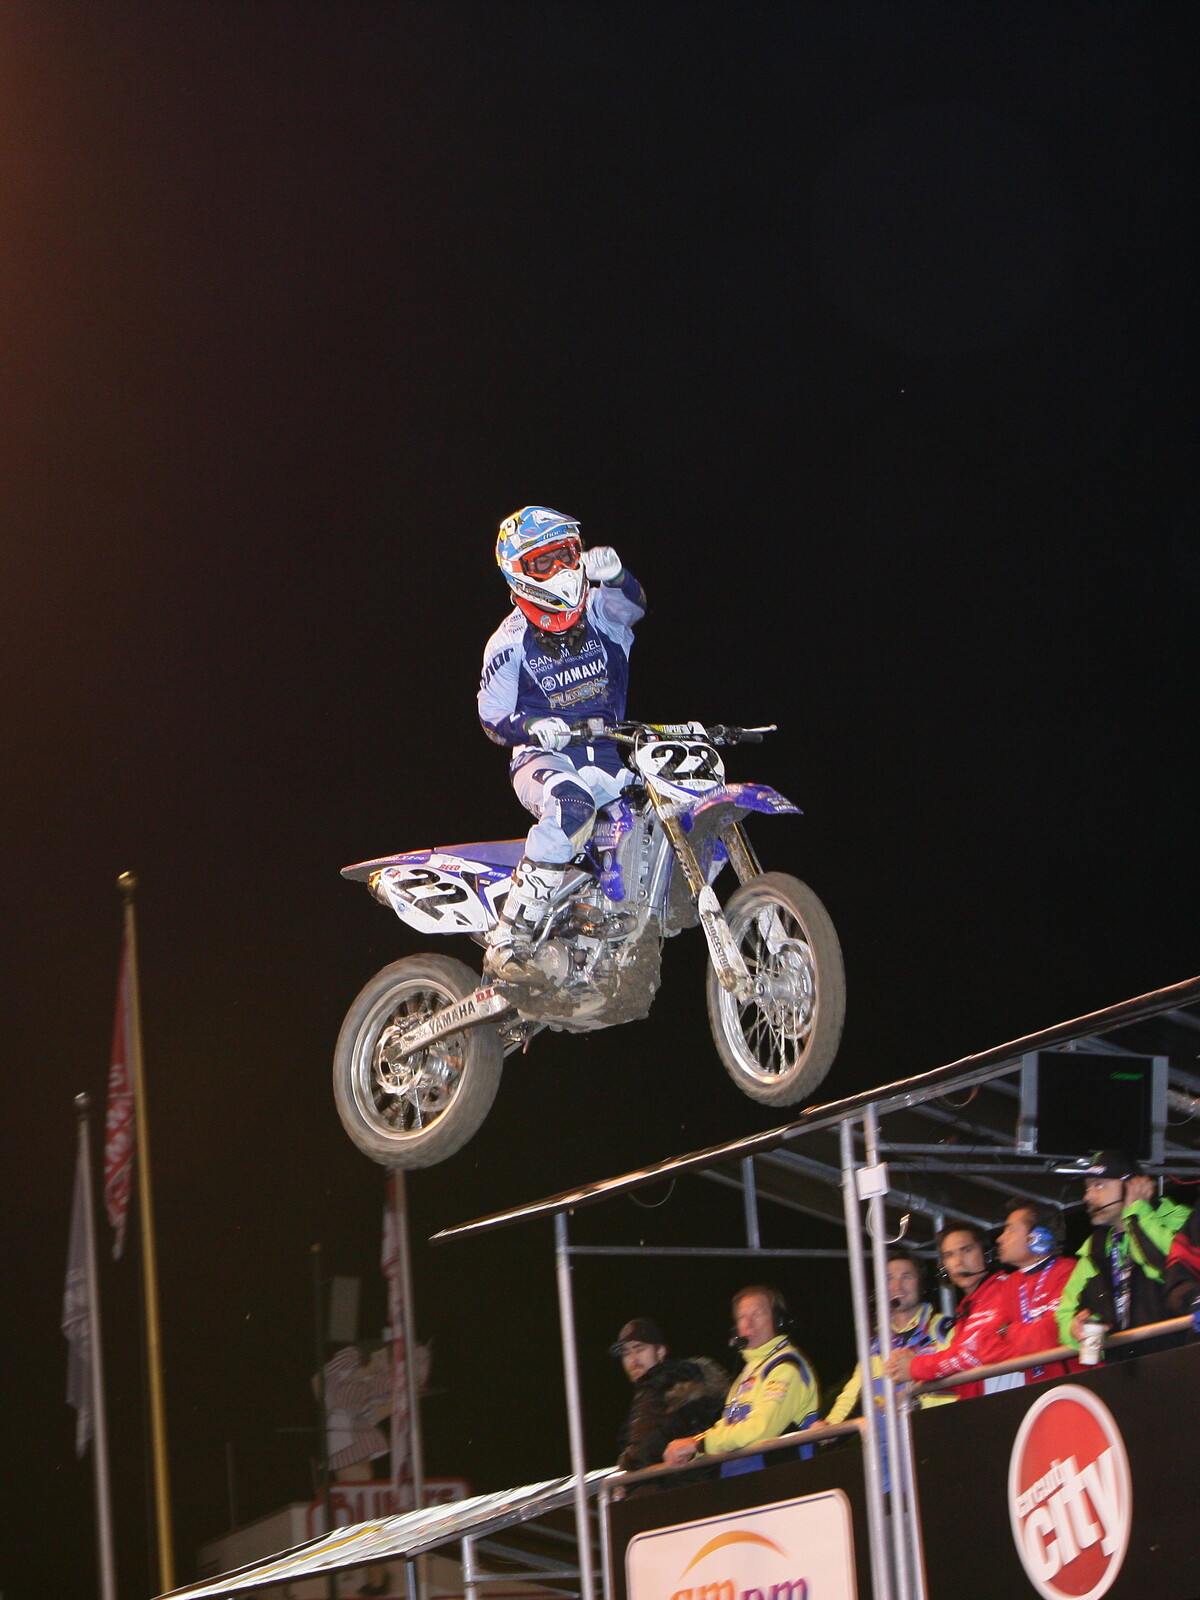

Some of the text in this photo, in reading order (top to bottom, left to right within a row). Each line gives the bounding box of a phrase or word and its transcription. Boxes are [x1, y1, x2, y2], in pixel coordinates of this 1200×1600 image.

[529, 639, 601, 669] SAN MUEL
[555, 659, 606, 687] YAMAHA
[650, 744, 720, 782] 22
[439, 864, 461, 872] REED
[392, 868, 469, 921] 22
[429, 1001, 477, 1035] YAMAHA
[1016, 1455, 1079, 1518] circuit
[1024, 1445, 1122, 1583] city
